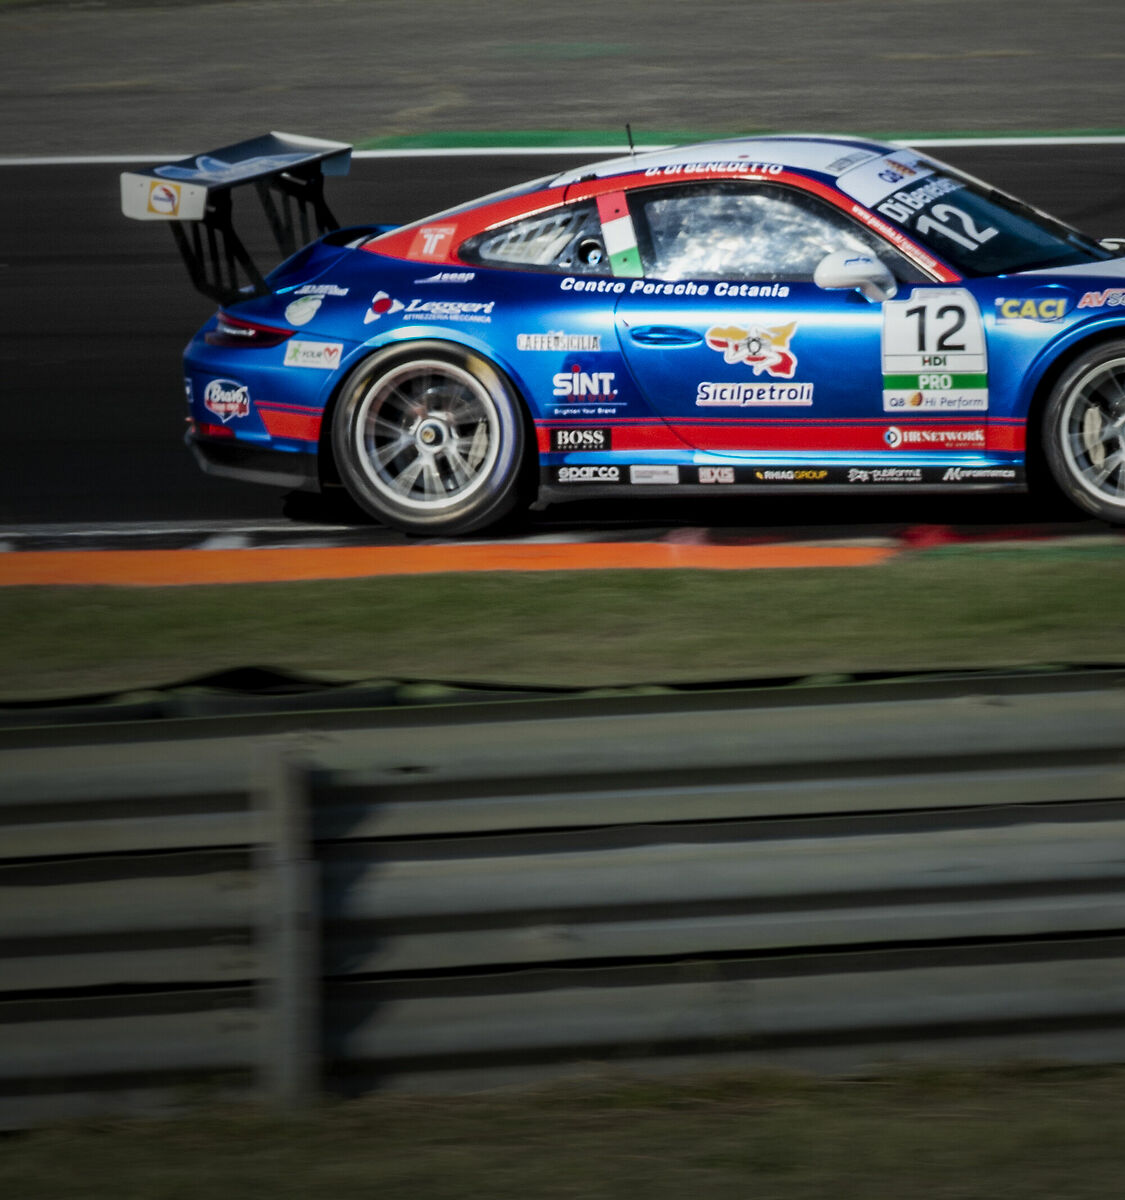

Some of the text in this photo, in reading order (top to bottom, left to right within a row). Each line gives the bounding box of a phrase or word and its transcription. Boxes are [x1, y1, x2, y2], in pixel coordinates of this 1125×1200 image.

[684, 159, 783, 175] BENEDETTO
[915, 203, 999, 251] 12
[560, 277, 790, 298] Centro Porsche Catania
[404, 299, 495, 314] Leggeri
[1002, 299, 1067, 319] CACI
[906, 304, 967, 352] 12
[922, 355, 947, 367] HDI
[918, 374, 953, 390] PRO
[698, 383, 812, 404] Sicilpetroli
[925, 397, 937, 407] Hi
[940, 396, 984, 409] Perform
[557, 430, 605, 445] BOSS
[558, 466, 620, 482] sparco
